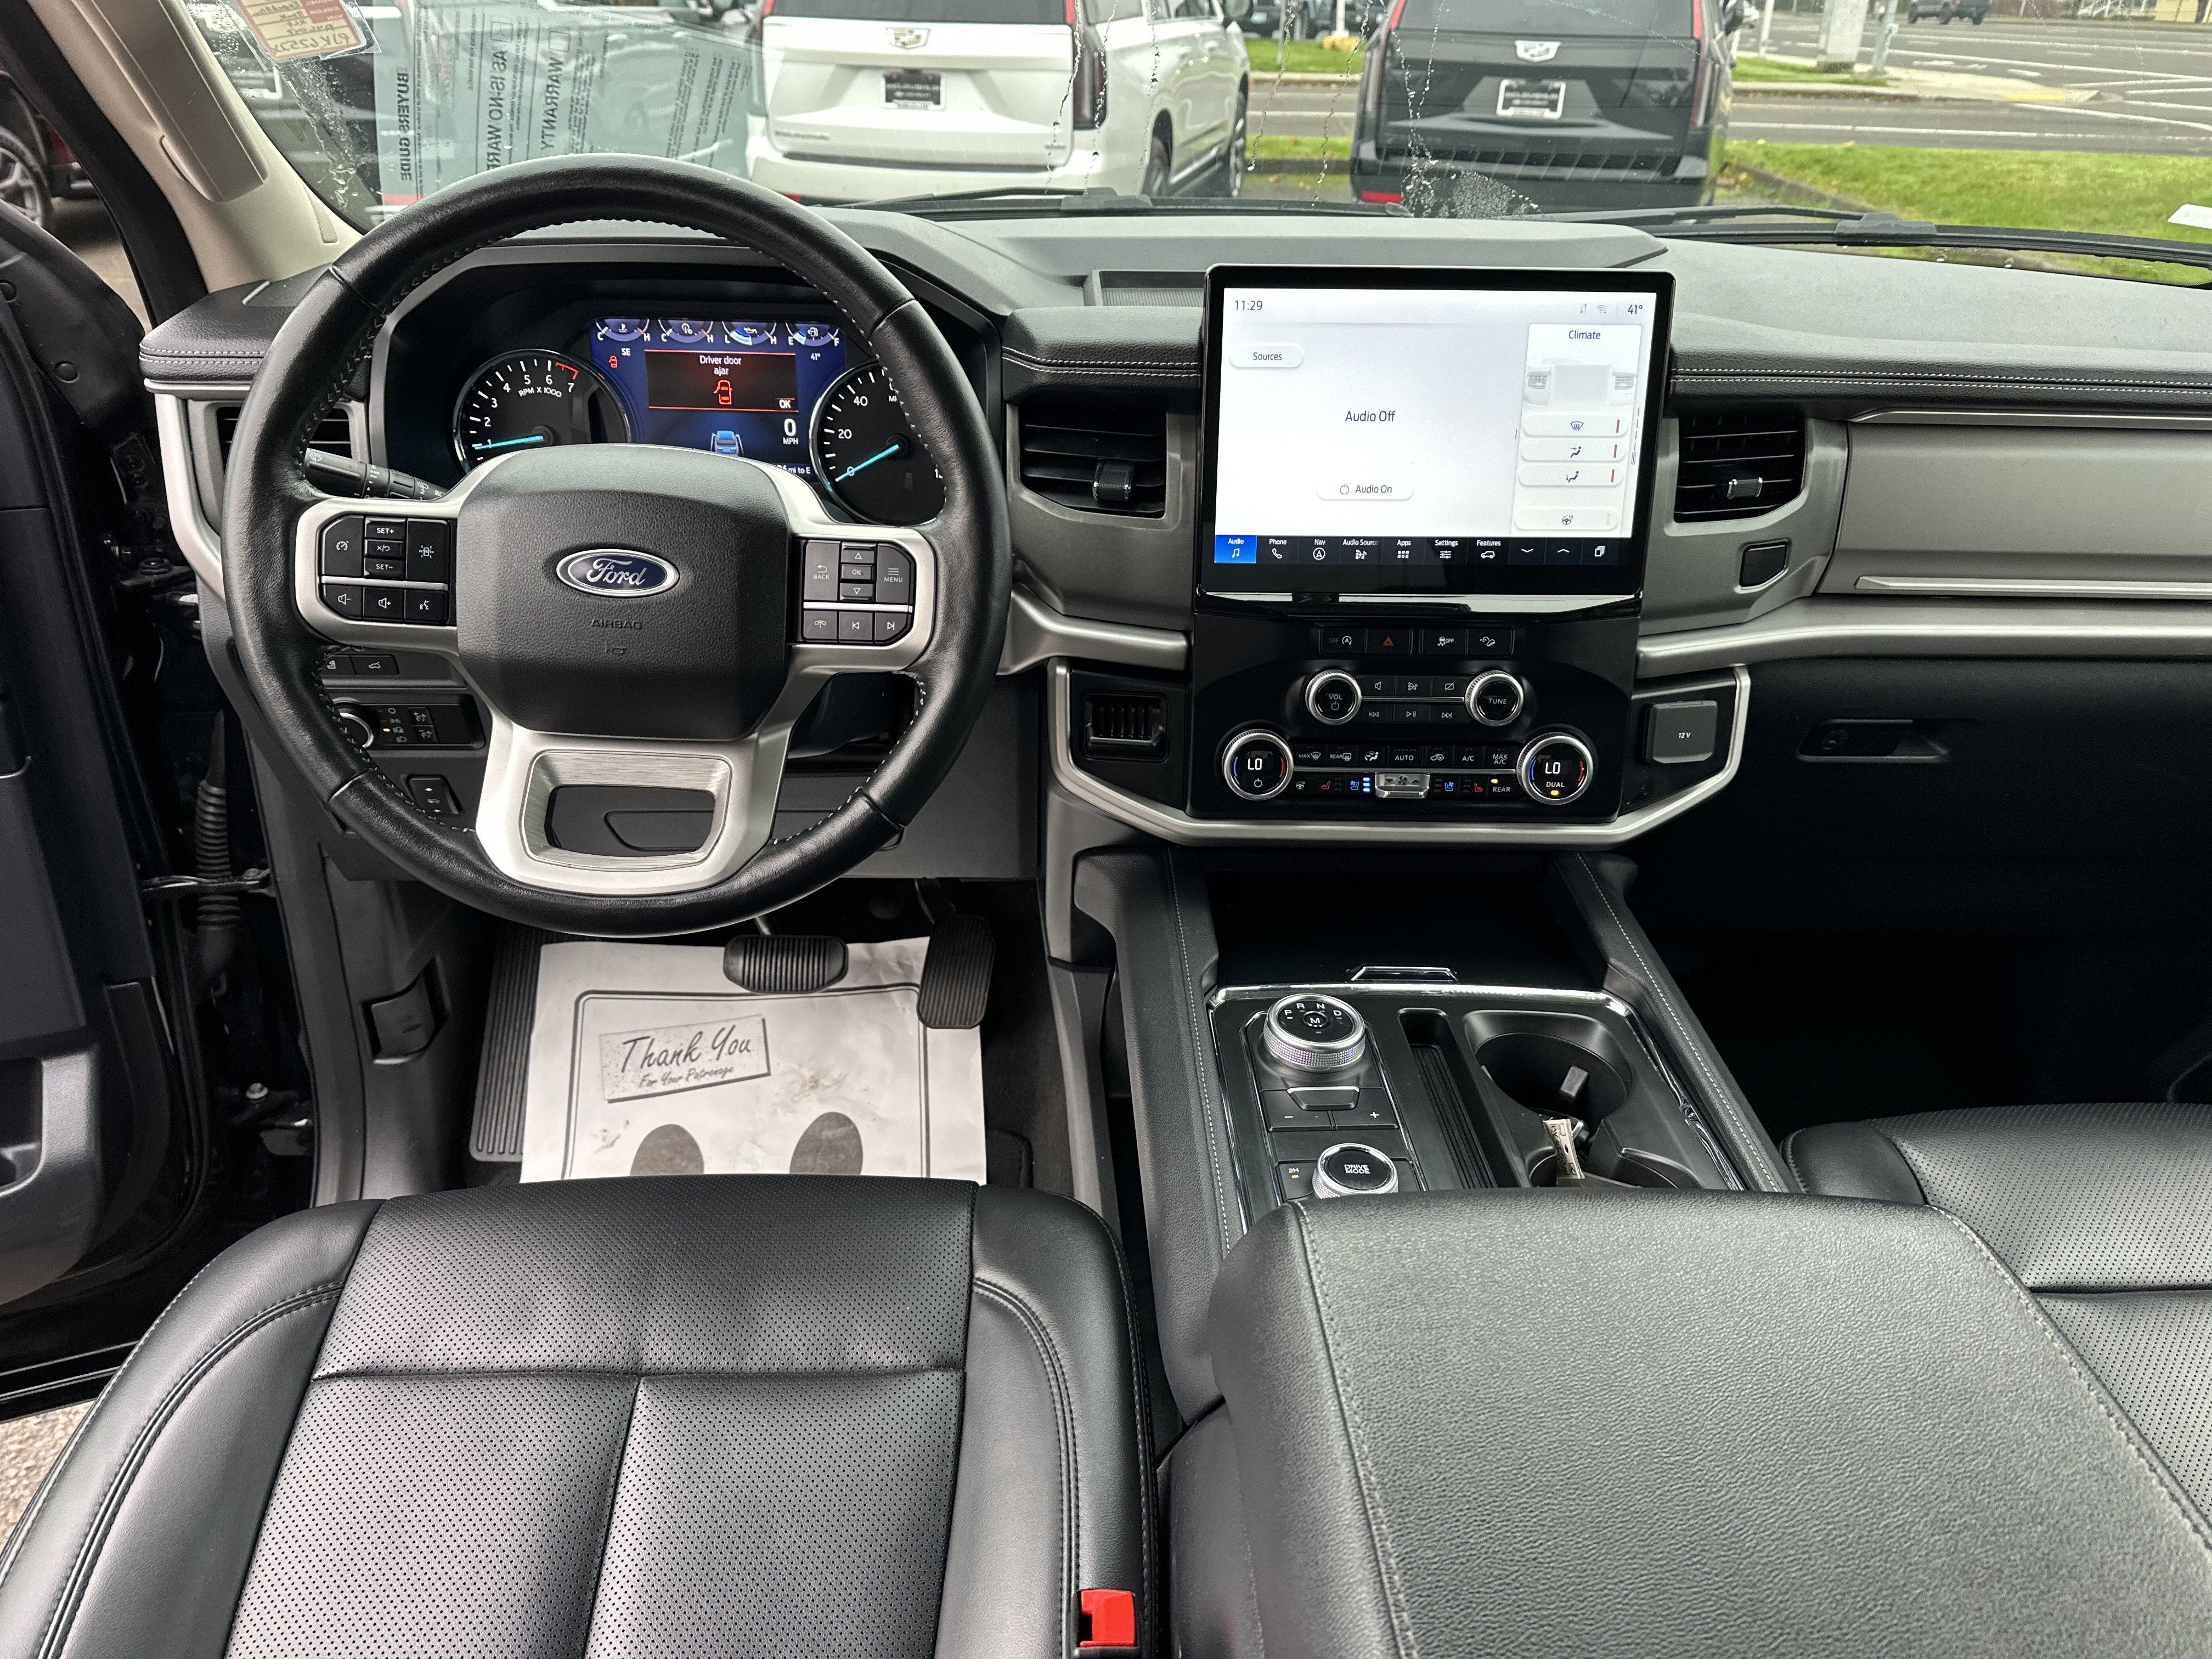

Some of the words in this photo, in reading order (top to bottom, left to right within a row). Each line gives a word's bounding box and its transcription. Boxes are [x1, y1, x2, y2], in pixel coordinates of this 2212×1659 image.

[1235, 300, 1263, 311] 11:29
[1627, 304, 1643, 314] 41°
[597, 332, 603, 341] C
[643, 333, 650, 342] H
[661, 333, 667, 342] C
[707, 334, 713, 343] H
[724, 335, 730, 343] L
[770, 336, 777, 345] H
[788, 336, 794, 345] E
[1568, 330, 1601, 340] Climate
[834, 338, 839, 346] F
[621, 348, 631, 356] SE
[1252, 352, 1283, 361] Sources
[699, 356, 722, 366] Driver
[724, 356, 742, 365] door
[714, 366, 729, 376] ajar
[523, 374, 531, 385] 5
[545, 374, 553, 385] 6
[503, 382, 511, 393] 4
[518, 387, 535, 397] RPM
[543, 387, 562, 398] 1000
[567, 382, 574, 393] 7
[490, 397, 498, 408] 3
[779, 399, 791, 409] OK
[853, 396, 868, 407] 40
[483, 416, 492, 427] 2
[1345, 410, 1376, 422] Audio
[1379, 410, 1396, 422] Off
[783, 418, 797, 437] 0
[838, 428, 852, 439] 20
[782, 437, 799, 445] MPH
[1356, 484, 1379, 494] Audio
[1380, 484, 1392, 494] On
[586, 557, 648, 586] Ford
[591, 618, 643, 630] AIRBAG
[1247, 758, 1262, 770] LO
[1544, 761, 1561, 774] LO
[621, 1030, 703, 1073] Thank
[711, 1024, 751, 1061] You
[639, 1073, 657, 1088] For
[661, 1071, 683, 1086] Your
[686, 1065, 734, 1081] Patronage
